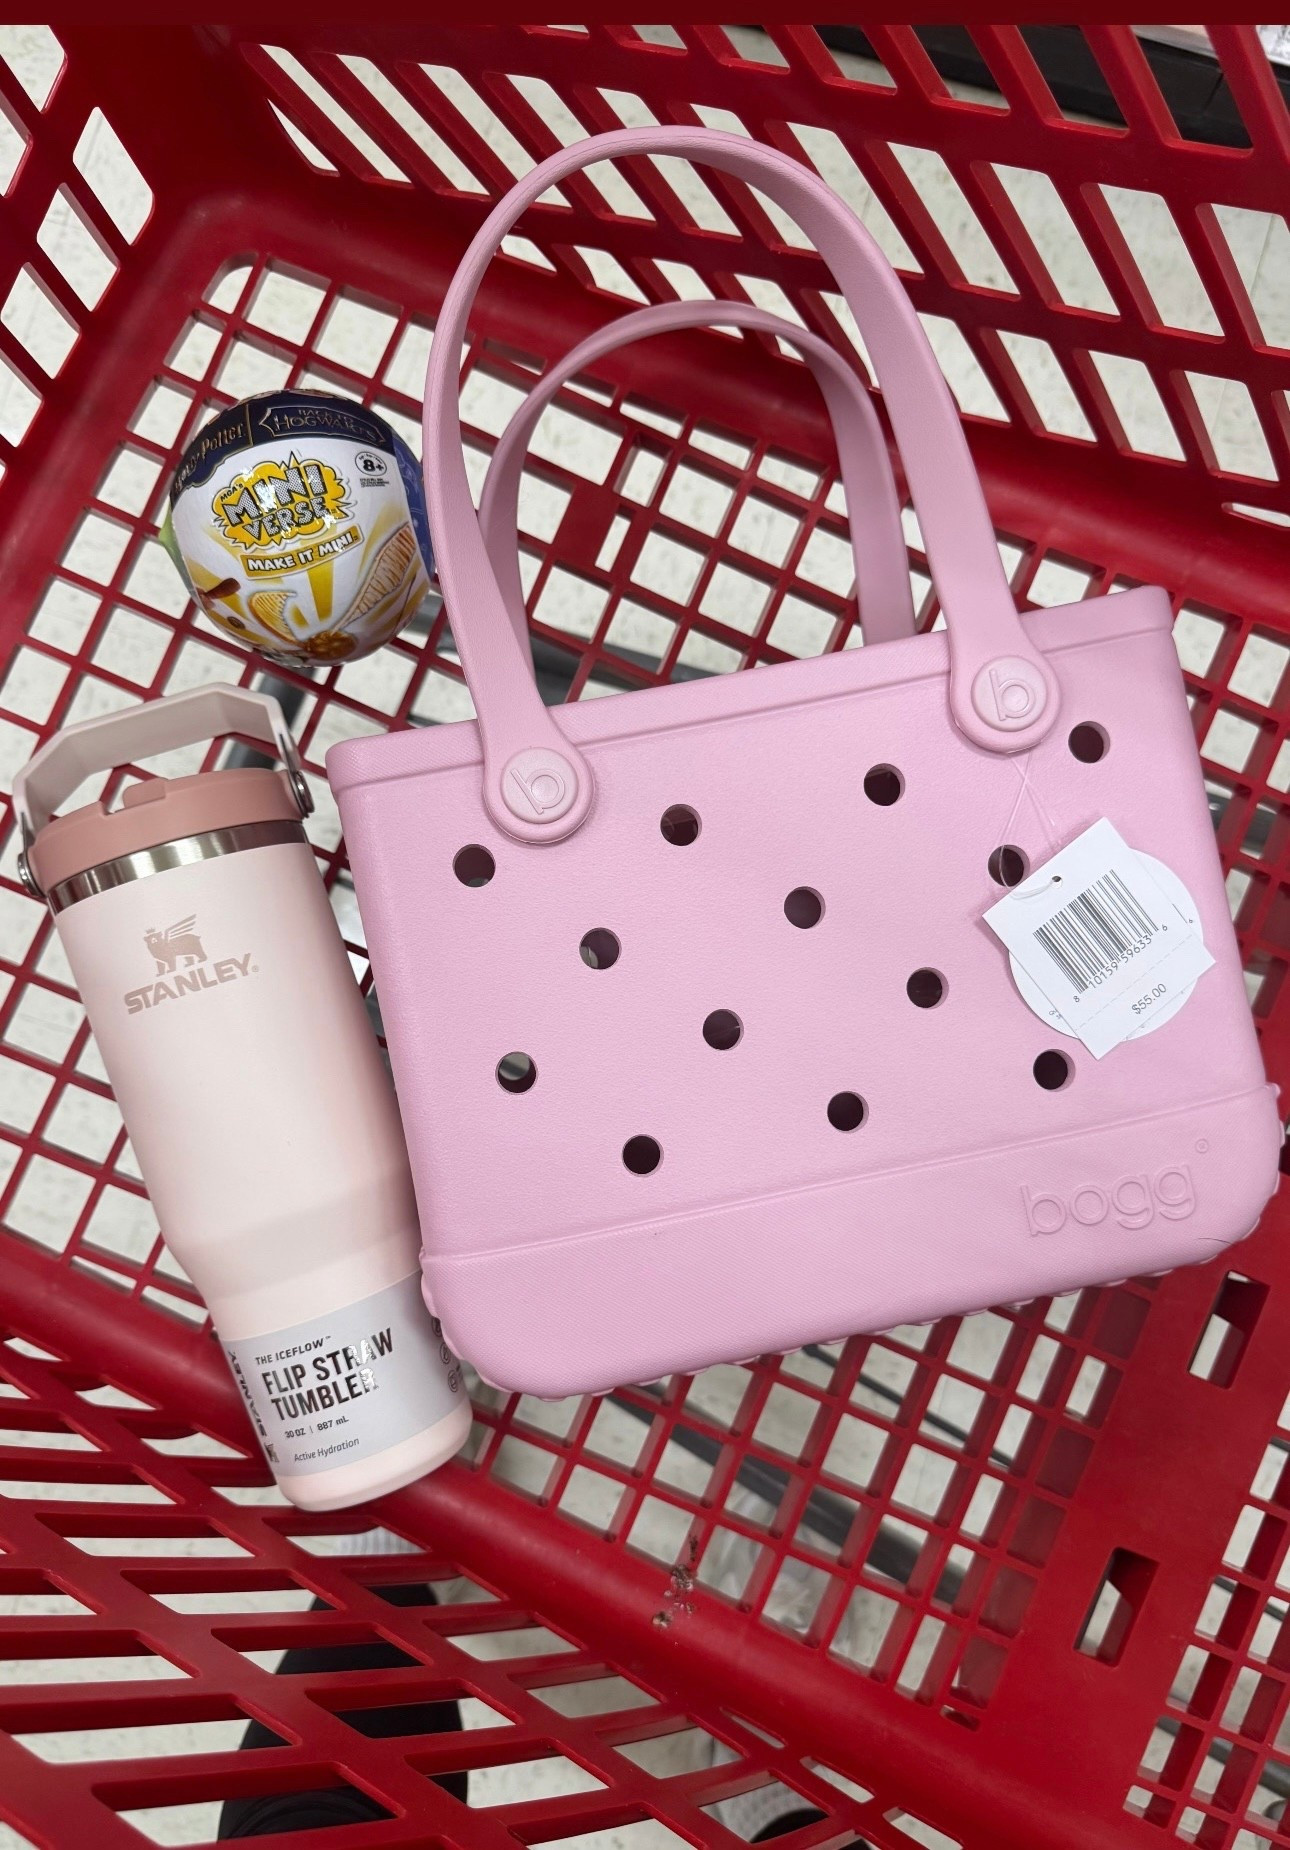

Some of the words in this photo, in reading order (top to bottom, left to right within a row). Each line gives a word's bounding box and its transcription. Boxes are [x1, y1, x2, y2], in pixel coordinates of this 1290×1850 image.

[201, 423, 244, 460] Potter
[363, 459, 385, 472] 8+
[222, 464, 328, 527] MINI
[242, 496, 332, 540] VERSE
[247, 555, 296, 571] MAKE
[298, 549, 314, 564] IT
[318, 532, 353, 557] MINI
[1088, 960, 1120, 990] 10159
[1120, 933, 1153, 964] 59633
[1160, 923, 1169, 932] 6
[124, 953, 251, 1014] STANLEY
[1131, 982, 1168, 1015] $55.00
[1020, 1162, 1197, 1238] bogg
[255, 1354, 273, 1366] THE
[261, 1363, 306, 1395] FLIP
[312, 1327, 394, 1381] STRAW
[270, 1368, 379, 1421] TUMBLER
[317, 1420, 333, 1431] 887
[335, 1415, 349, 1426] mL
[294, 1451, 317, 1462] Active
[317, 1438, 360, 1458] Hydration
